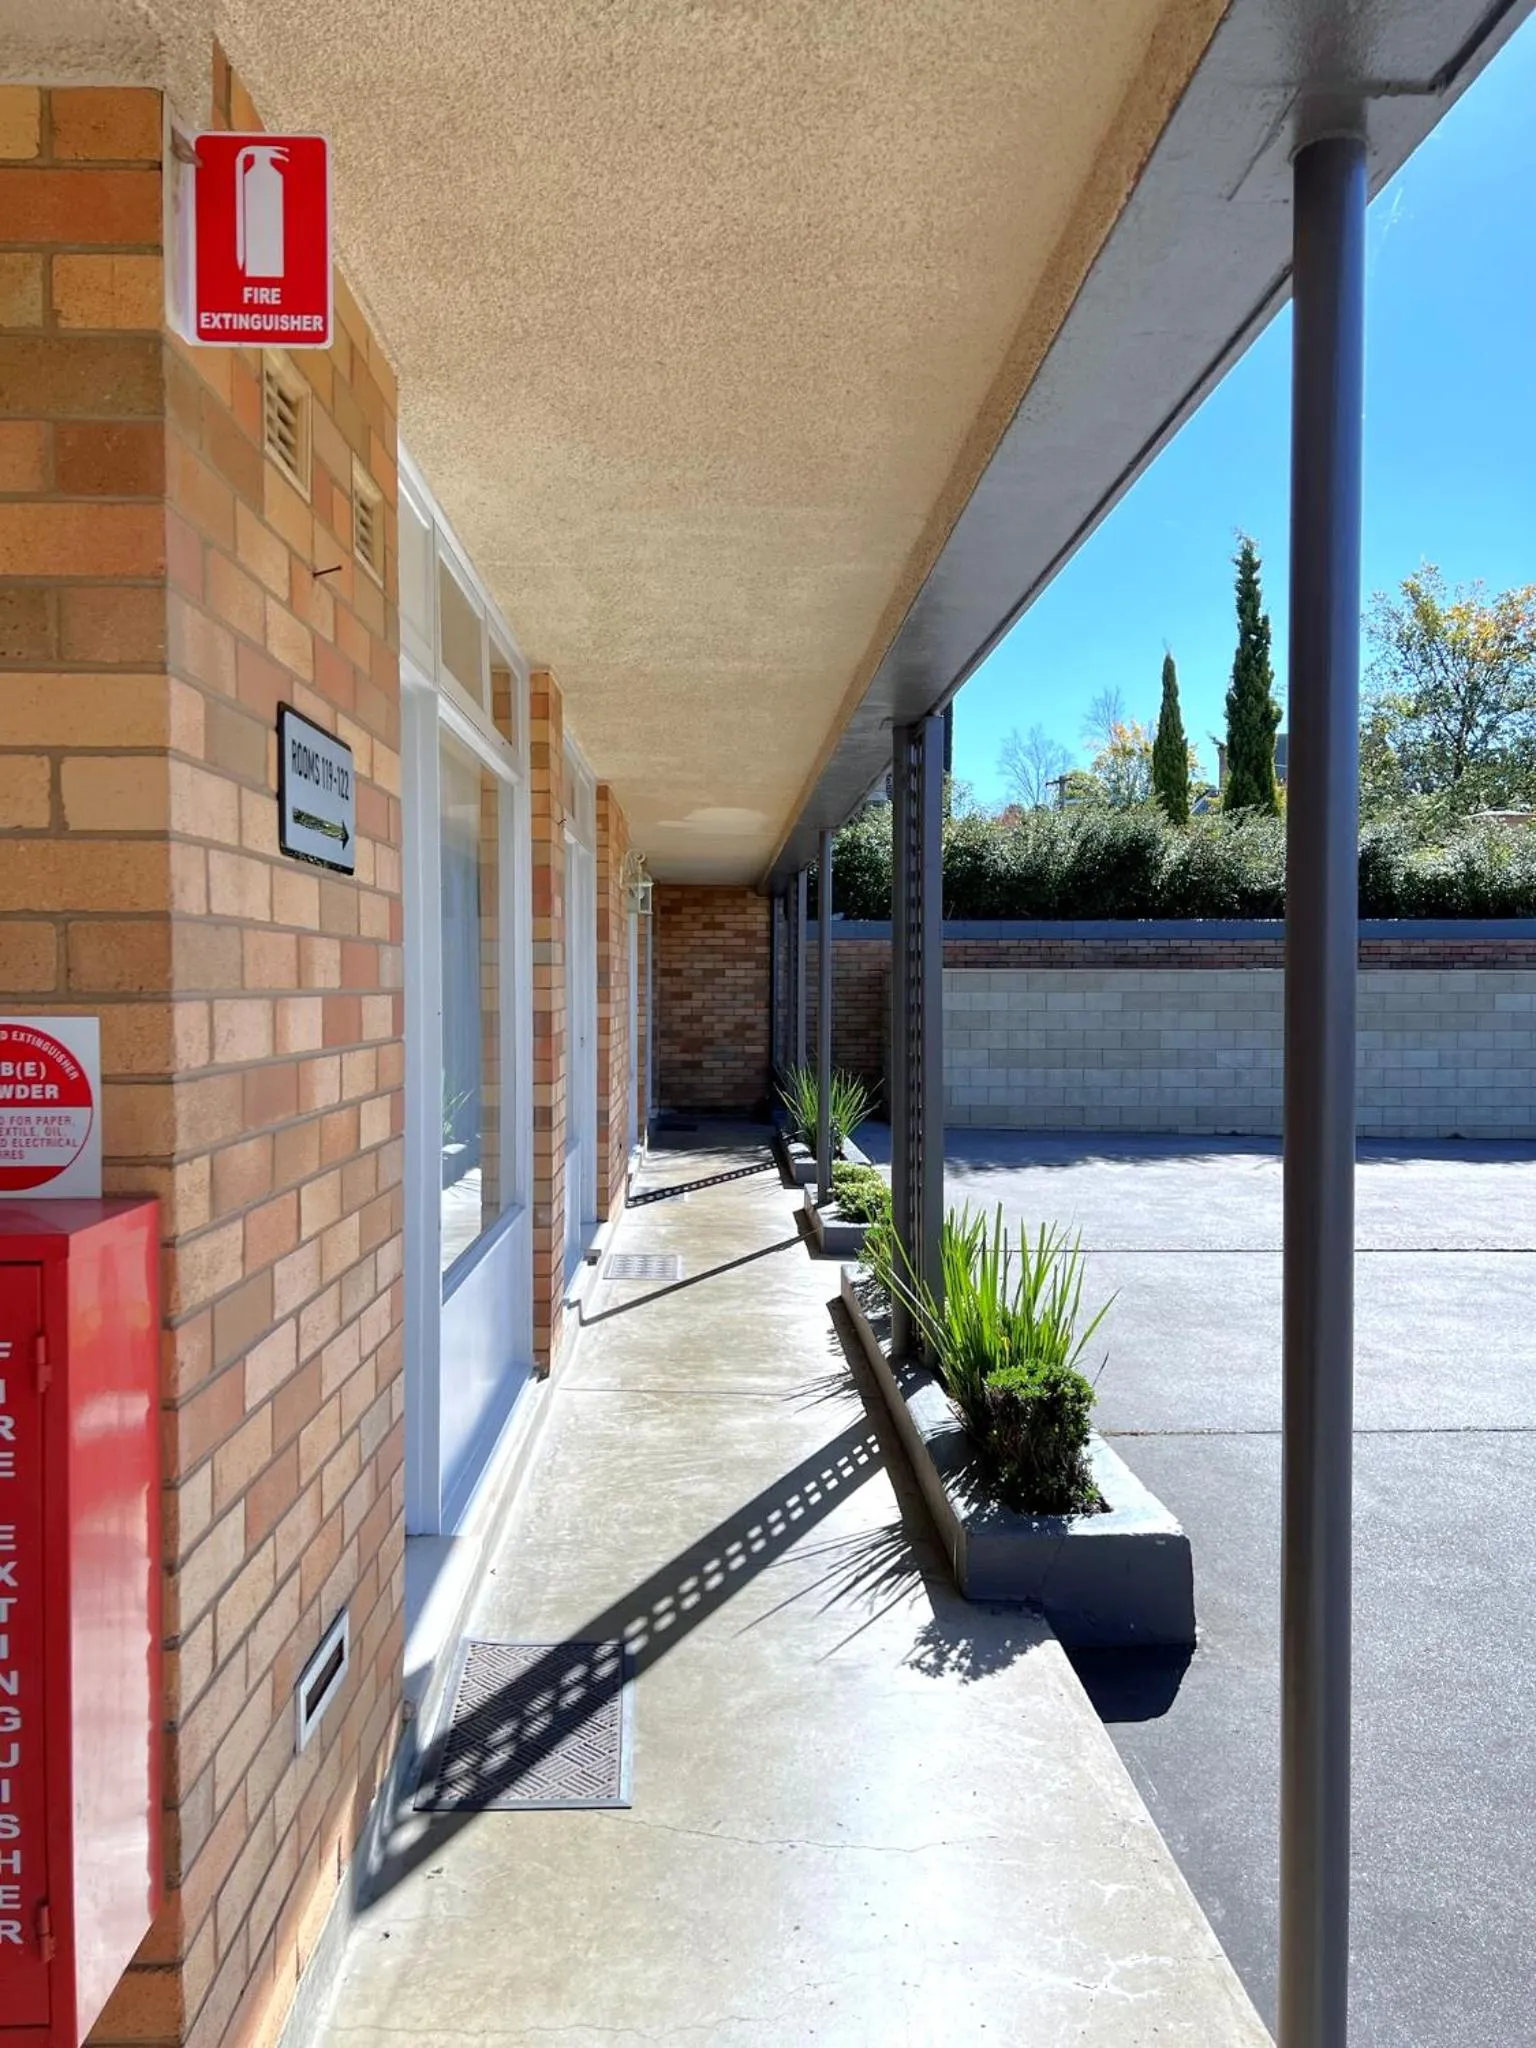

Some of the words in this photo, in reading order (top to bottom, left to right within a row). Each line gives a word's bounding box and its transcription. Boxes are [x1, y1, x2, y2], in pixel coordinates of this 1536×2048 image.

[243, 286, 281, 304] FIRE
[200, 312, 324, 331] EXTINGUISHER
[291, 738, 320, 786] ROOMS
[321, 756, 349, 801] 119-122
[11, 1030, 79, 1080] EXTINGUISHER
[10, 1116, 31, 1126] FOR
[12, 1138, 78, 1148] ELECTRICAL
